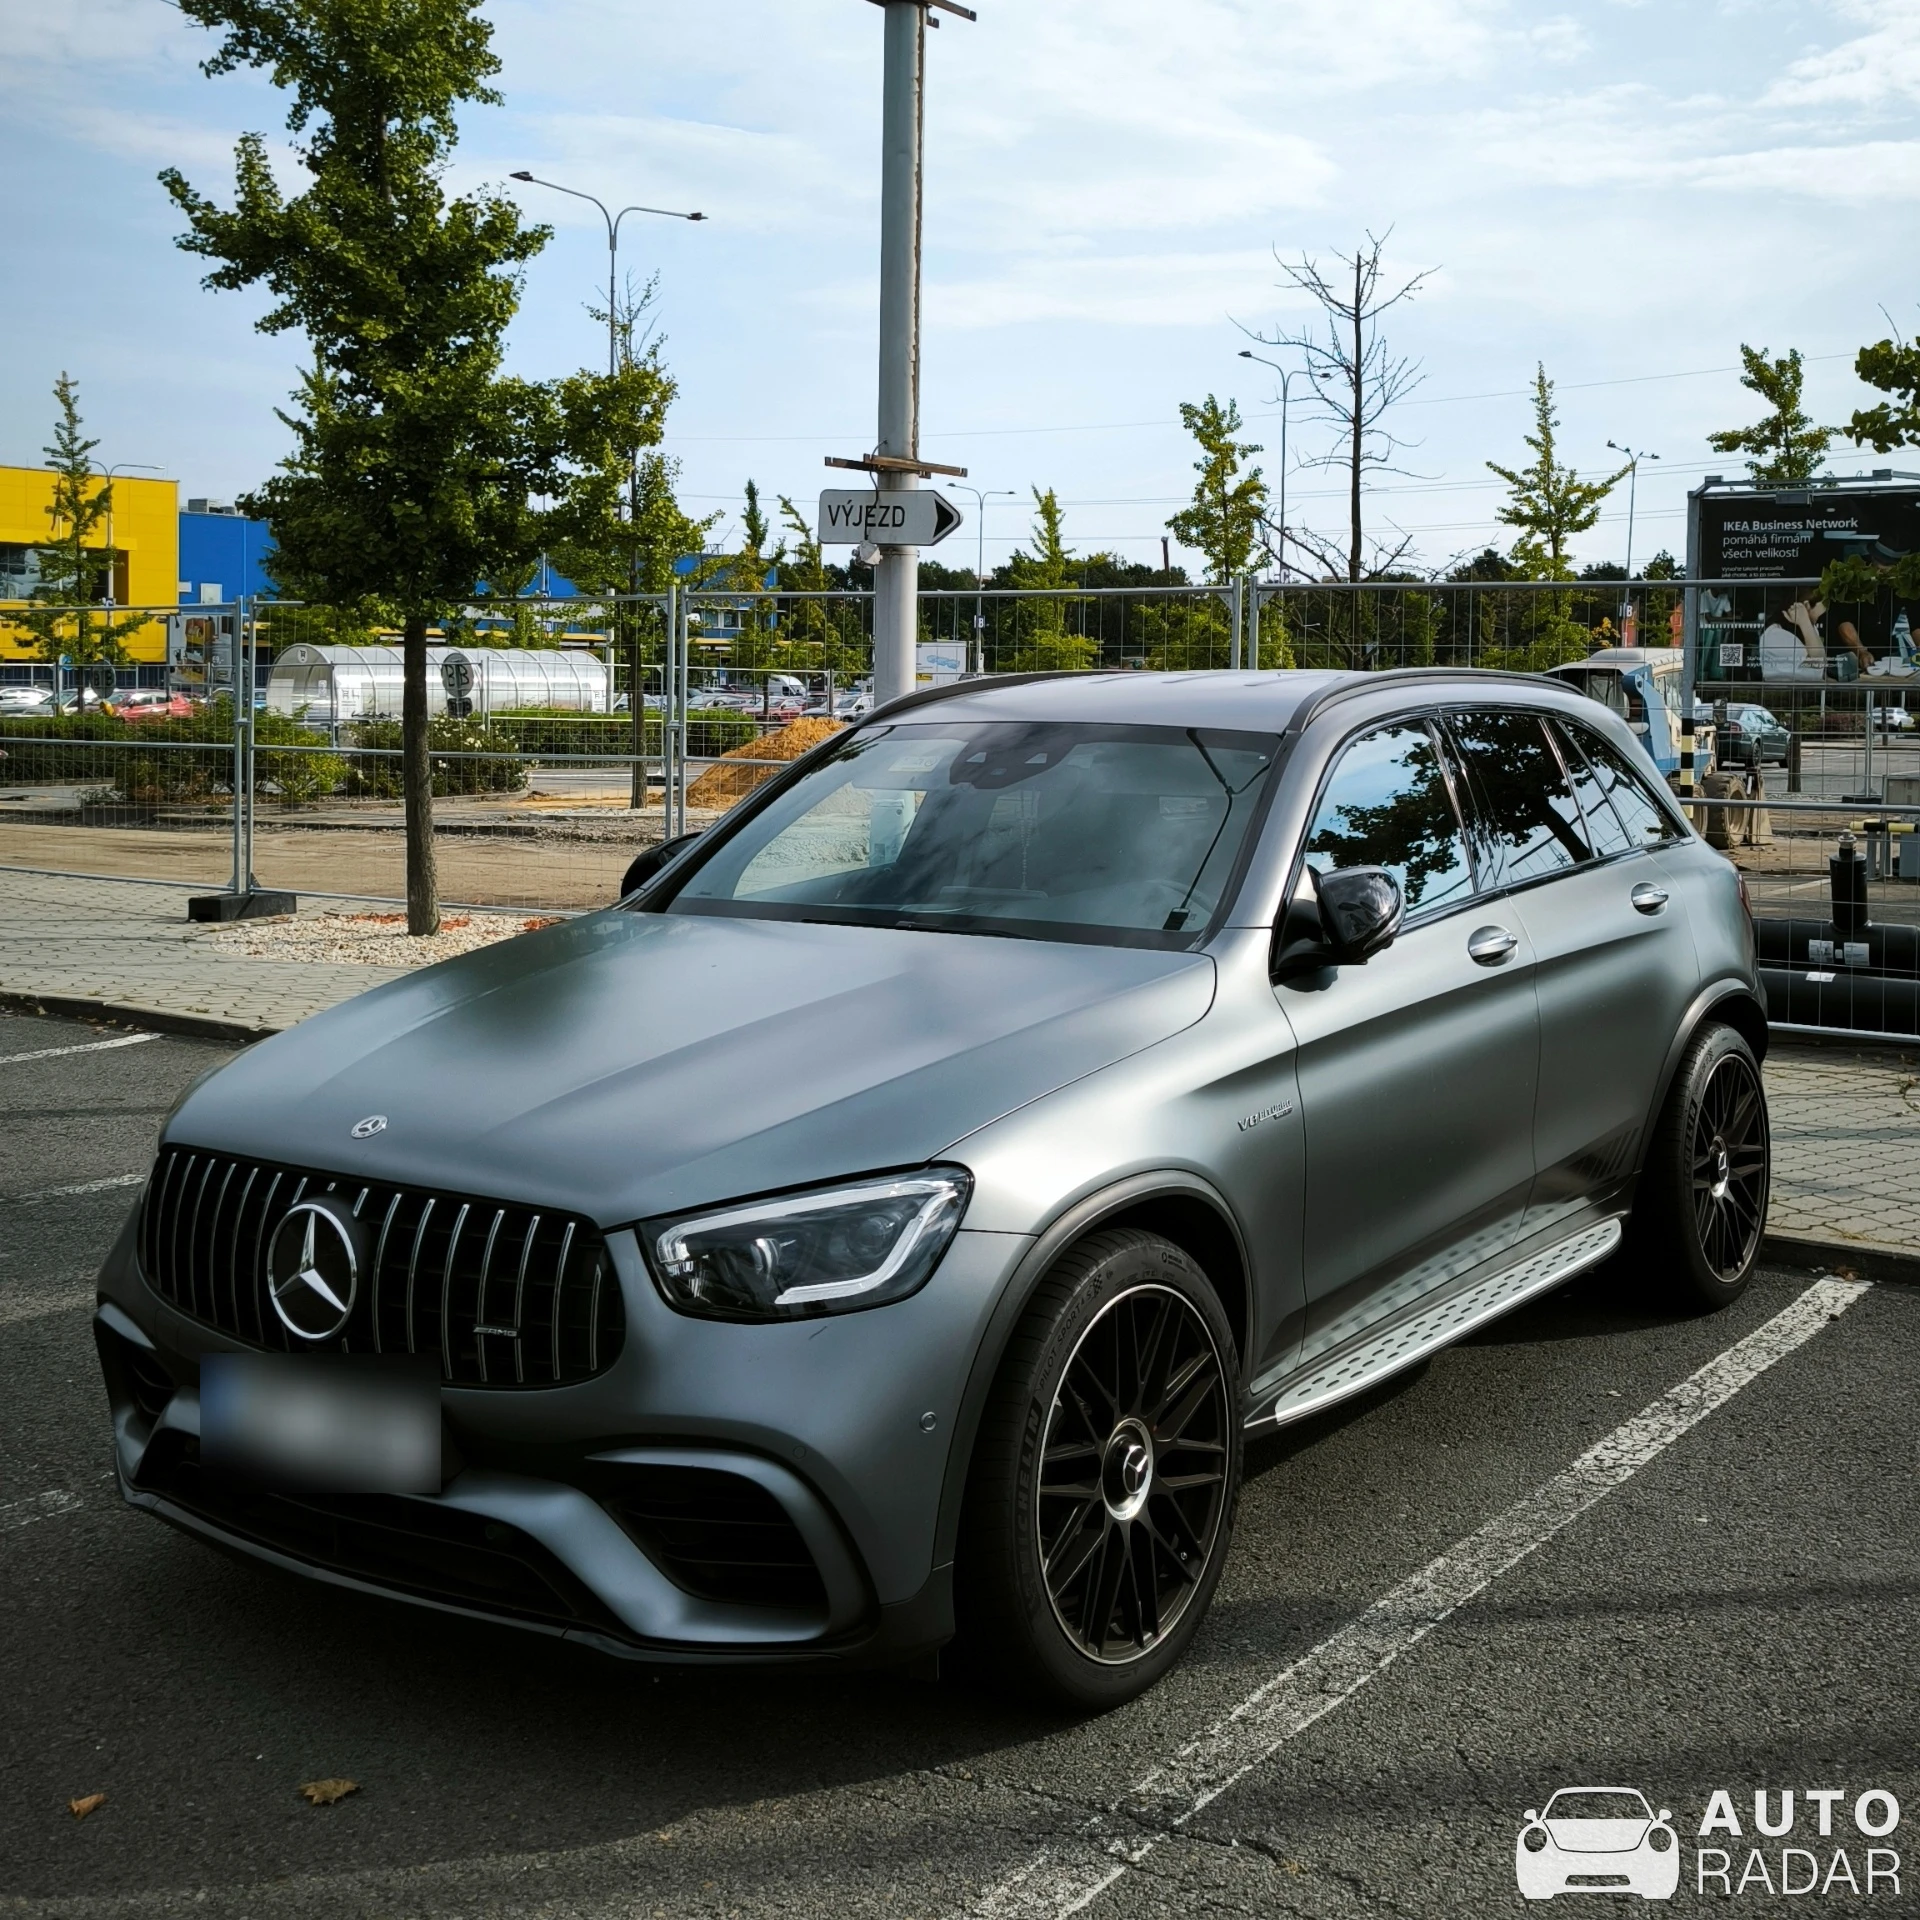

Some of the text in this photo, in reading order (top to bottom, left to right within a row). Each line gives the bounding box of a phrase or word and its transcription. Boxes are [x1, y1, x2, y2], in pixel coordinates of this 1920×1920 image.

[828, 499, 905, 527] VÝJEZD
[1723, 517, 1859, 532] IKEA Business Network
[1722, 532, 1811, 547] pomáhá firmám
[1721, 547, 1800, 559] všech velikostí
[488, 1328, 517, 1336] AMG
[1038, 1346, 1058, 1391] PILOT
[1057, 1304, 1081, 1343] SPORT
